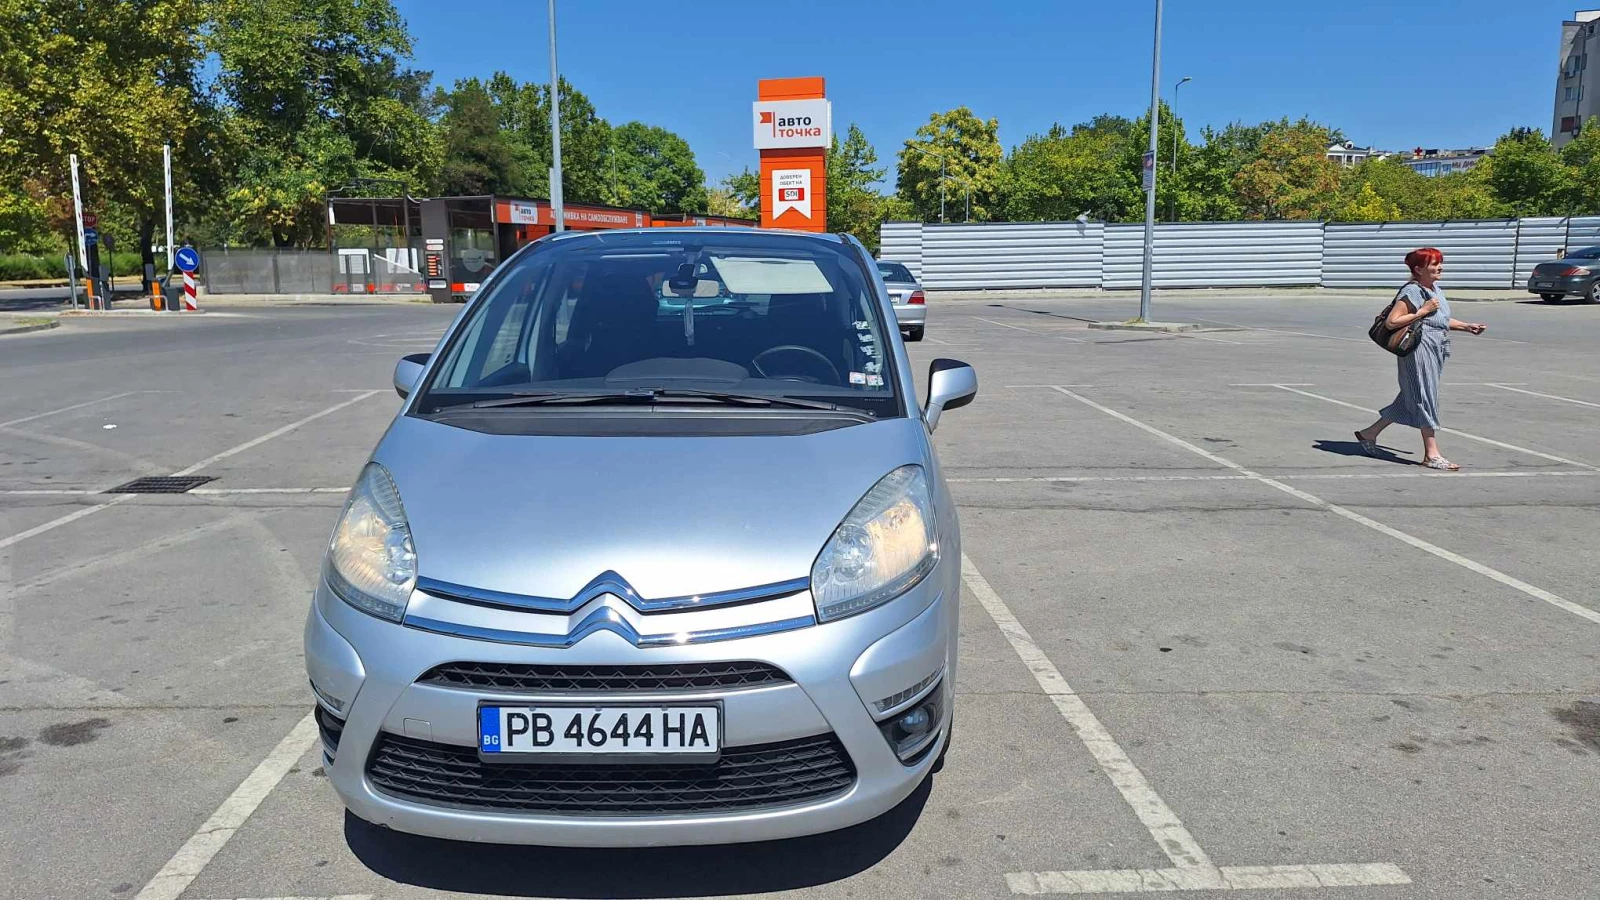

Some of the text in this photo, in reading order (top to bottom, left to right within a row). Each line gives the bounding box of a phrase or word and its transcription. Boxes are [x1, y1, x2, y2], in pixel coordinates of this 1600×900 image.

[778, 116, 812, 127] авто
[778, 127, 821, 138] точка
[507, 712, 710, 747] PB 4644 HA
[483, 734, 499, 745] BG
